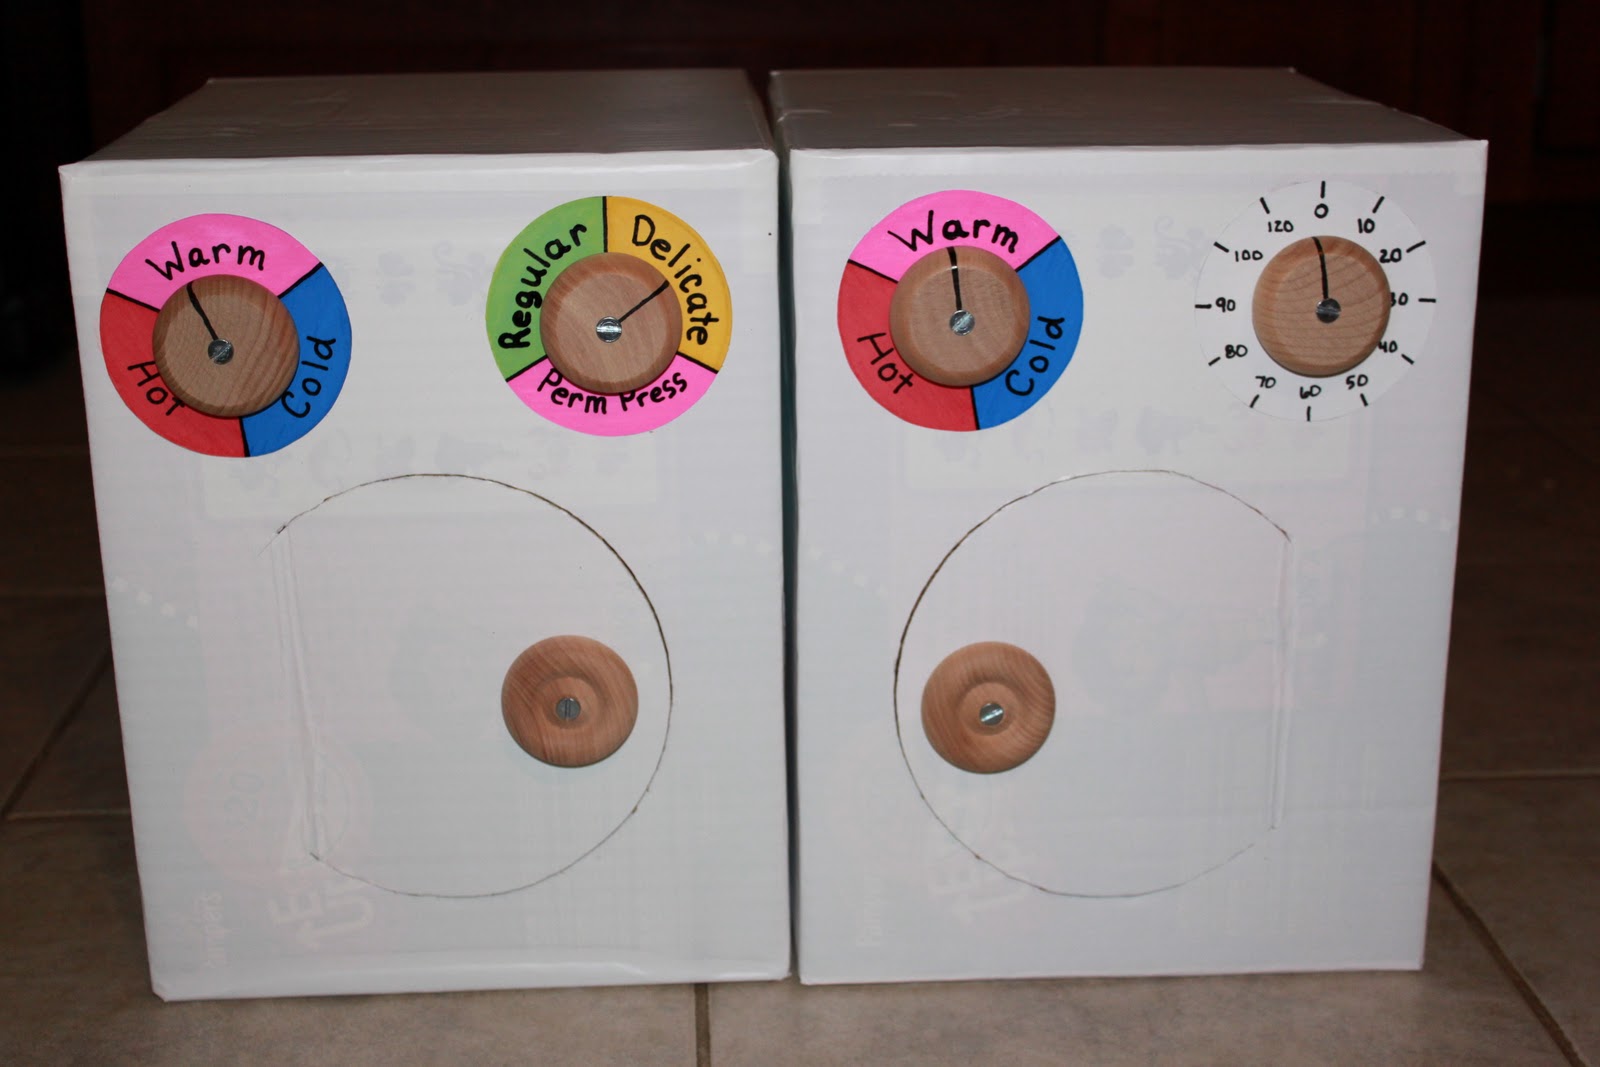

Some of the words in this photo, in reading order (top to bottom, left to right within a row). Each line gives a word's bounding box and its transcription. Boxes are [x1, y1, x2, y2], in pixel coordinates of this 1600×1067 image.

[1313, 202, 1330, 220] 0
[886, 209, 1020, 254] Warm
[1267, 219, 1295, 233] 120
[1356, 217, 1376, 235] 10
[144, 240, 267, 282] Warm
[1233, 249, 1264, 263] 100
[1378, 247, 1403, 264] 20
[497, 222, 588, 350] Regular
[631, 213, 721, 346] Delicate
[1214, 296, 1237, 313] 90
[1004, 315, 1066, 397] Cold
[1224, 343, 1249, 360] 80
[1377, 340, 1398, 354] 40
[856, 331, 915, 395] Hot
[280, 335, 338, 419] Cold
[1254, 375, 1277, 389] 70
[1345, 373, 1369, 391] 50
[126, 359, 188, 417] Hot
[536, 366, 608, 415] Perm
[618, 371, 688, 412] Press
[1298, 384, 1322, 400] 60
